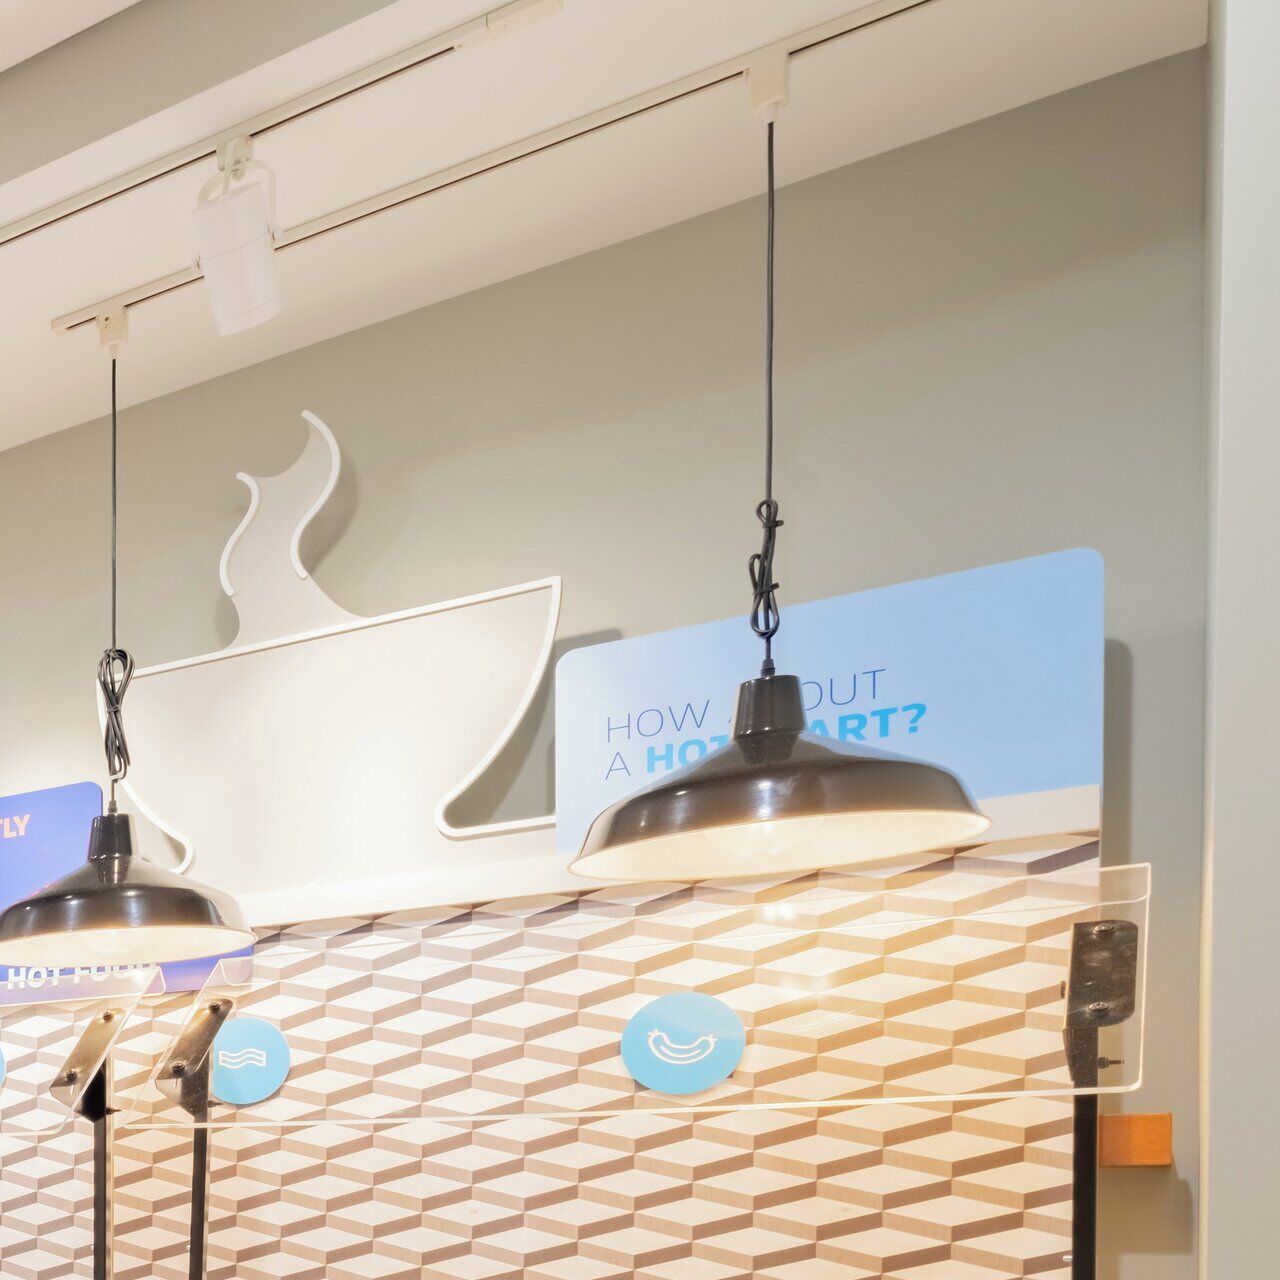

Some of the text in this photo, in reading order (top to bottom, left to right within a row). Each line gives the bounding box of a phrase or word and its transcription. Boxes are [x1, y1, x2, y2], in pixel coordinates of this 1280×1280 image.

[607, 699, 710, 743] HOW
[605, 751, 631, 780] A
[7, 967, 65, 990] HOT
